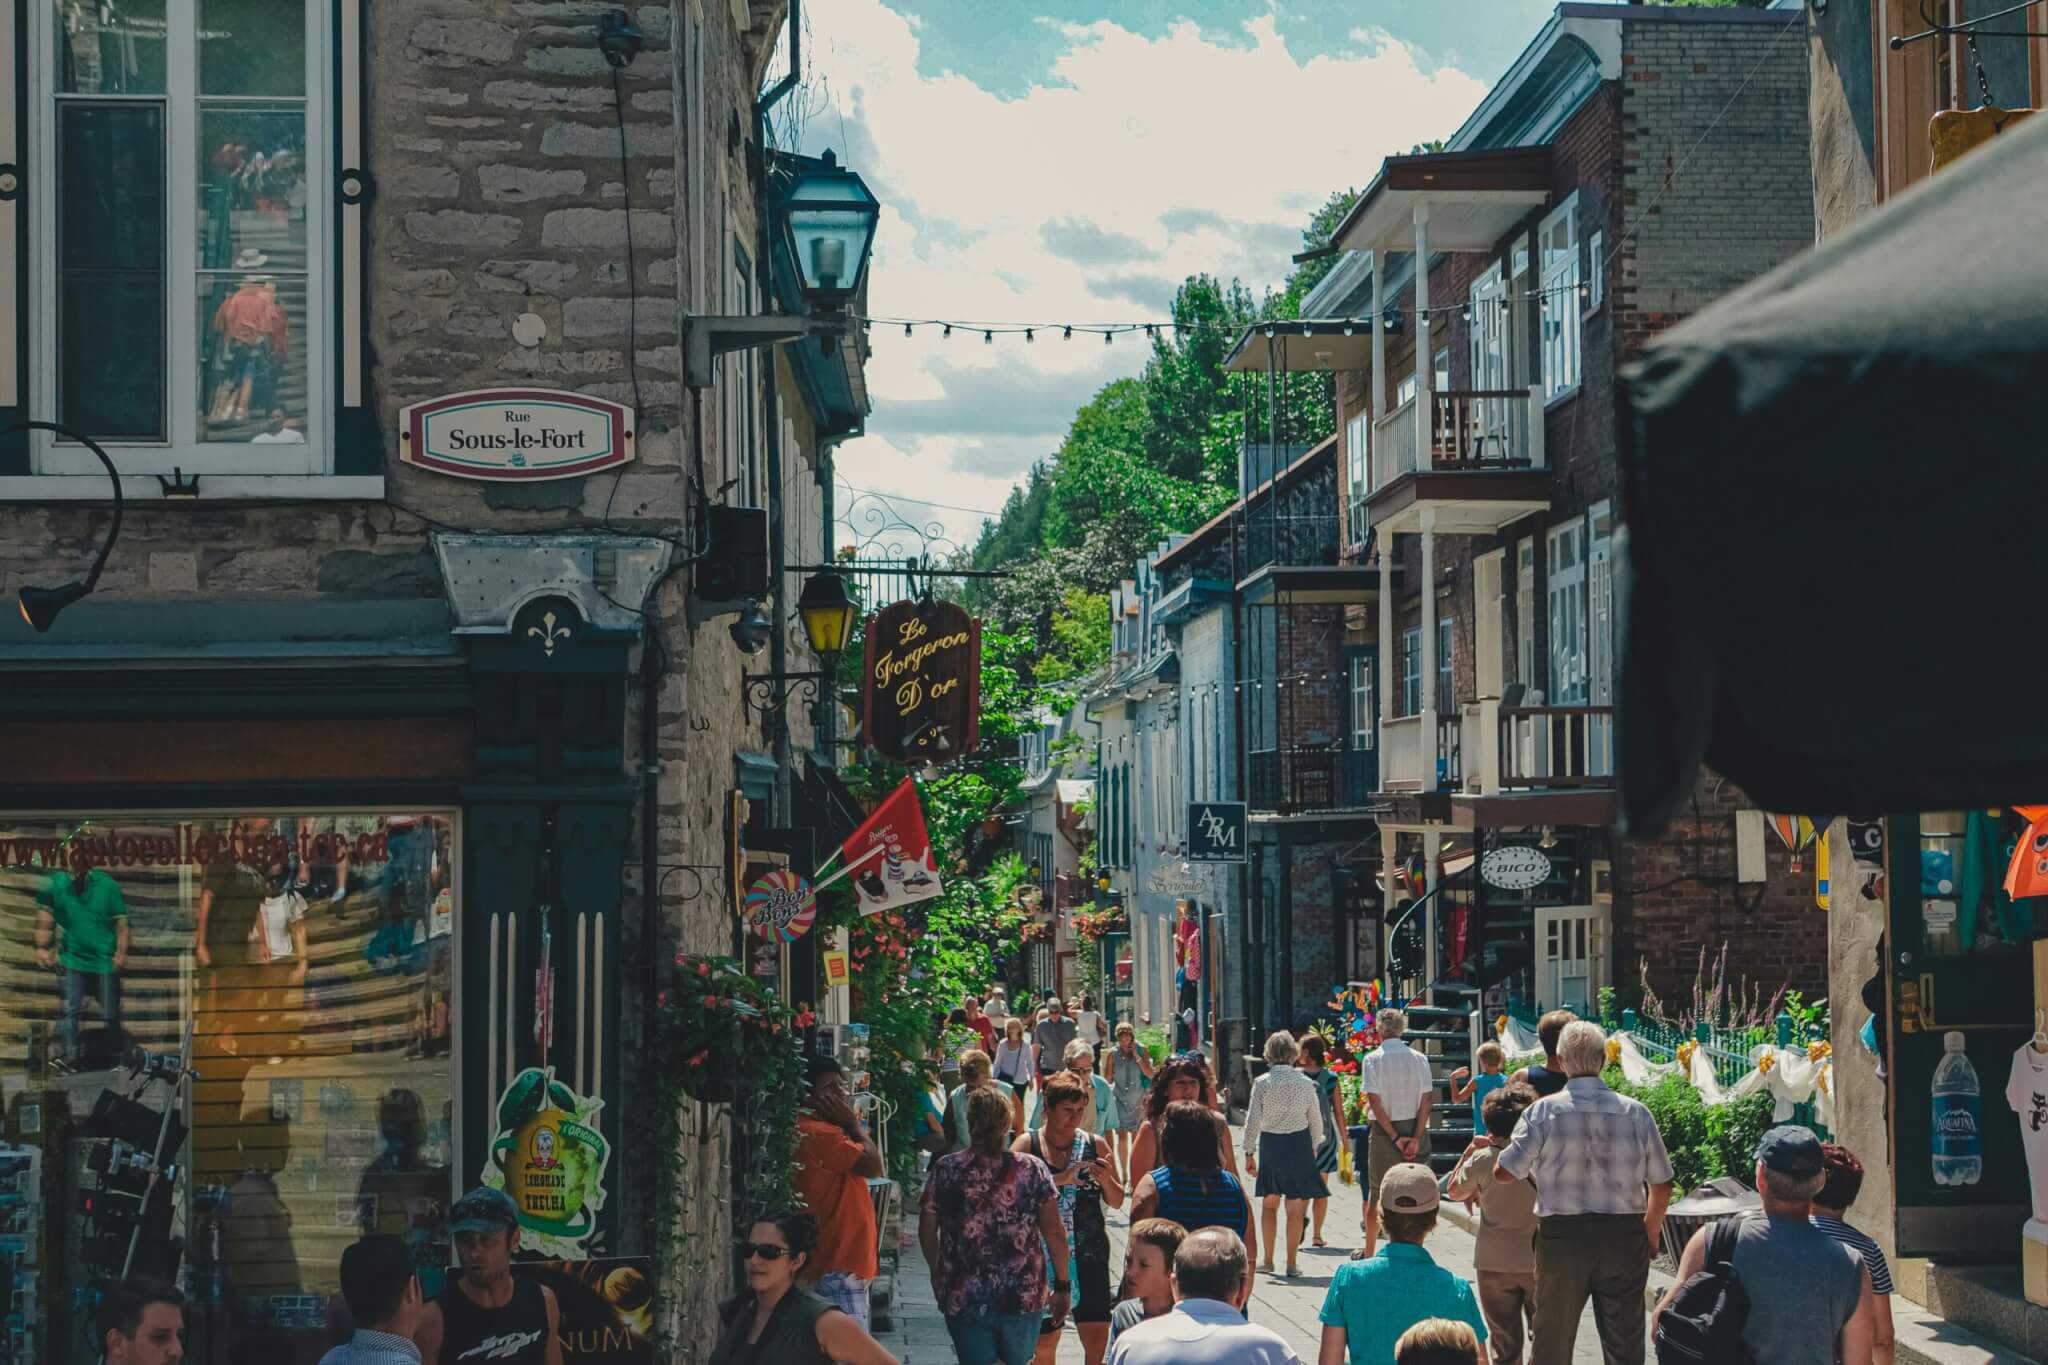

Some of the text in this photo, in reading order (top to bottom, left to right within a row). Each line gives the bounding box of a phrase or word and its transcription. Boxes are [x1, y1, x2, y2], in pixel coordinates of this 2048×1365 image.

[505, 411, 531, 422] Rue
[450, 428, 585, 449] Sous-le-Fort
[899, 617, 928, 645] Le
[875, 632, 970, 689] Forgeron
[1497, 864, 1536, 872] BICO
[771, 887, 809, 908] Bon
[752, 901, 800, 926] Bons
[557, 1324, 633, 1353] NUM
